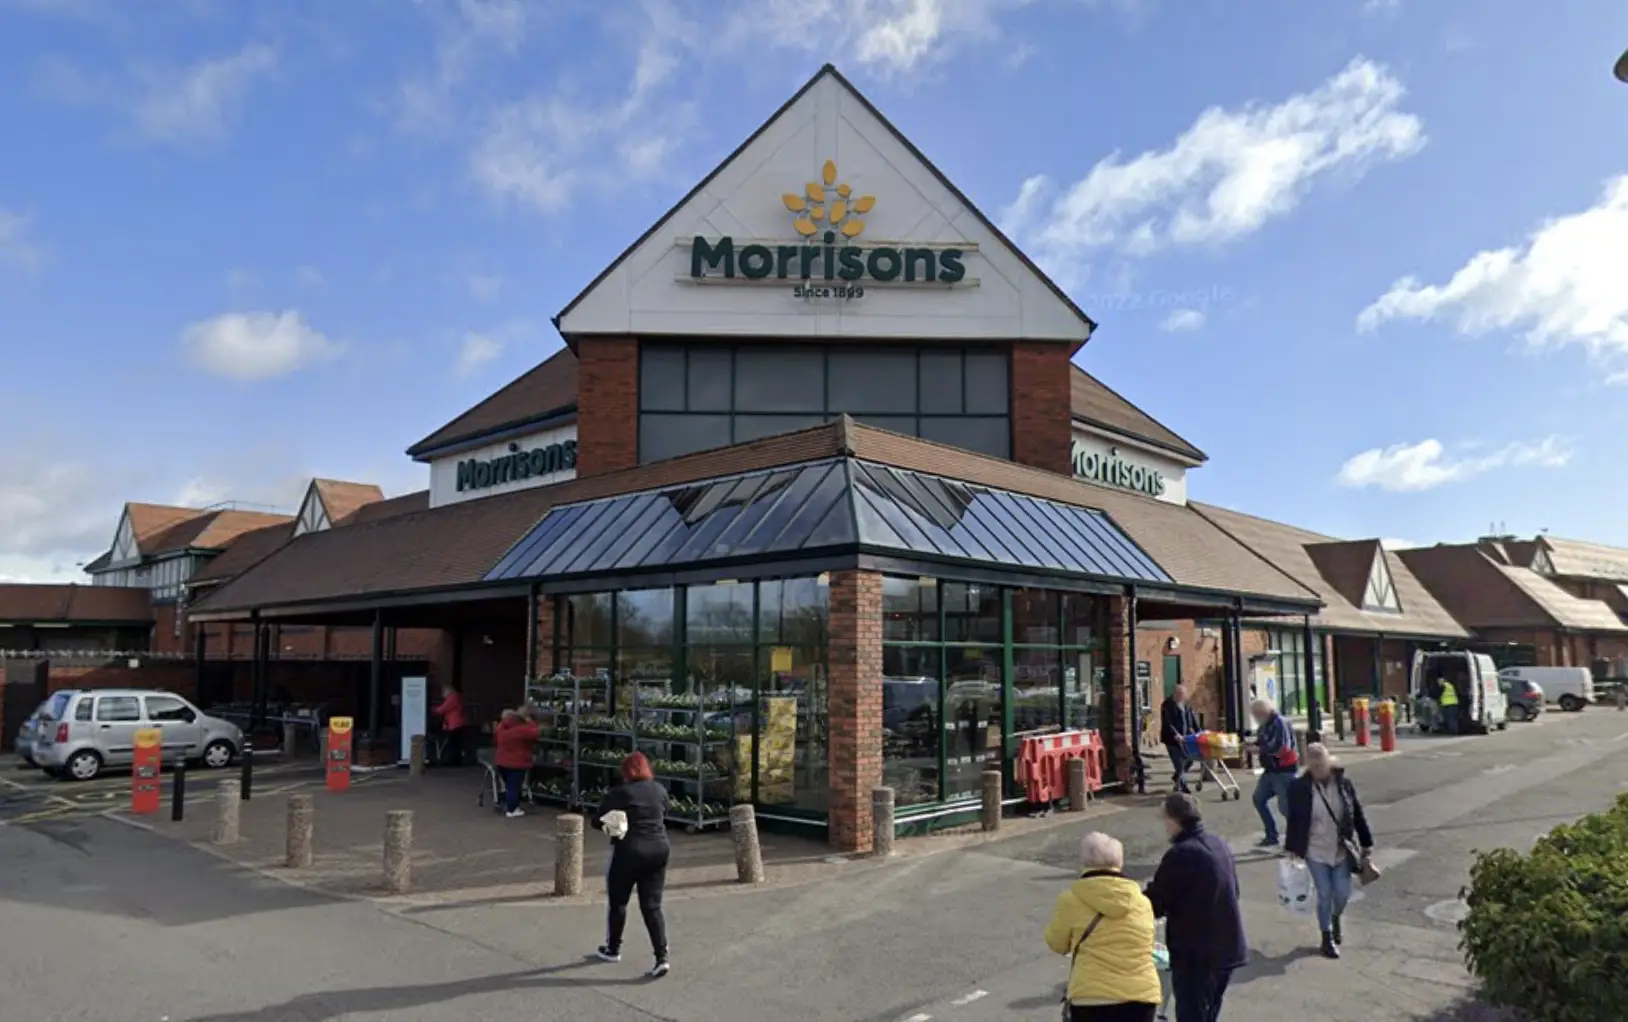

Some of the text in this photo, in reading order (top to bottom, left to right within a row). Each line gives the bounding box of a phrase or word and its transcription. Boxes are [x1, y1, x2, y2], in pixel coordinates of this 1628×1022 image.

[691, 231, 966, 283] Morrisons
[793, 286, 829, 298] Since
[456, 440, 577, 492] Morrisons
